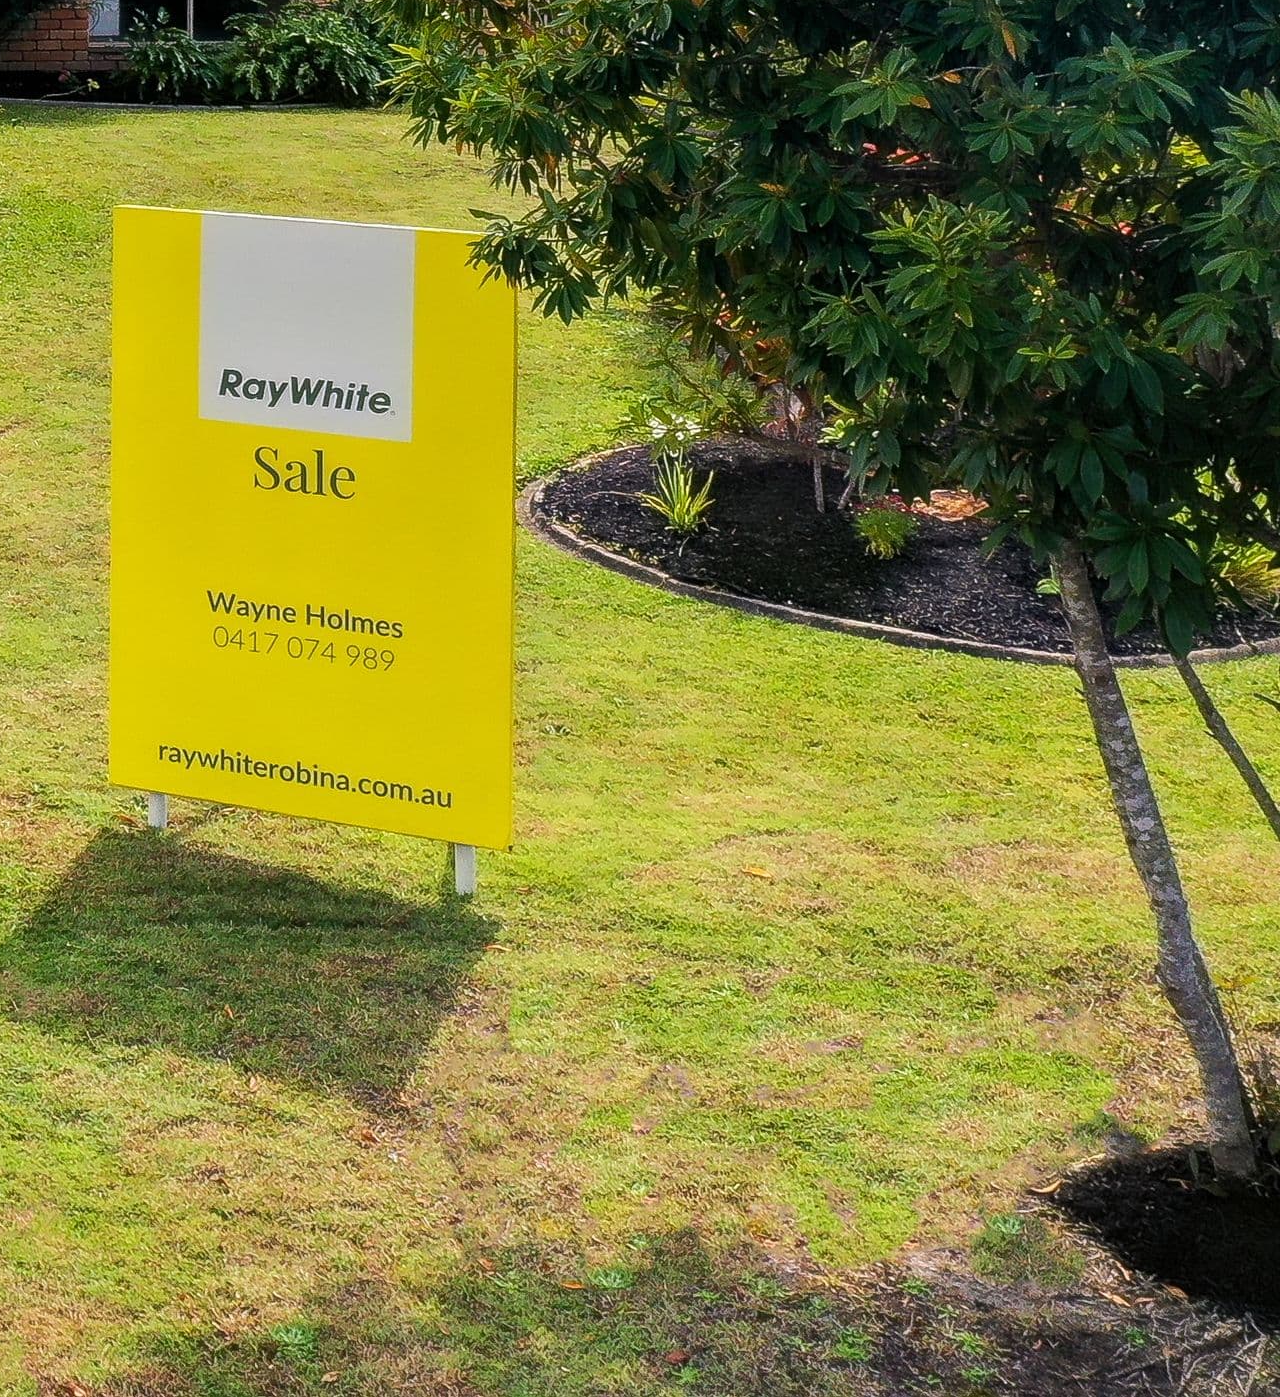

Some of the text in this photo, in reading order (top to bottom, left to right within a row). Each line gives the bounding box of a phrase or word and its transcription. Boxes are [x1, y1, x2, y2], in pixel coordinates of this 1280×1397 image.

[218, 368, 391, 415] RayWhite
[253, 446, 356, 500] Sale
[206, 590, 404, 639] Wayne Holmes
[213, 625, 395, 672] 0417 074 989
[158, 743, 453, 809] raywhiterobina.com.au
